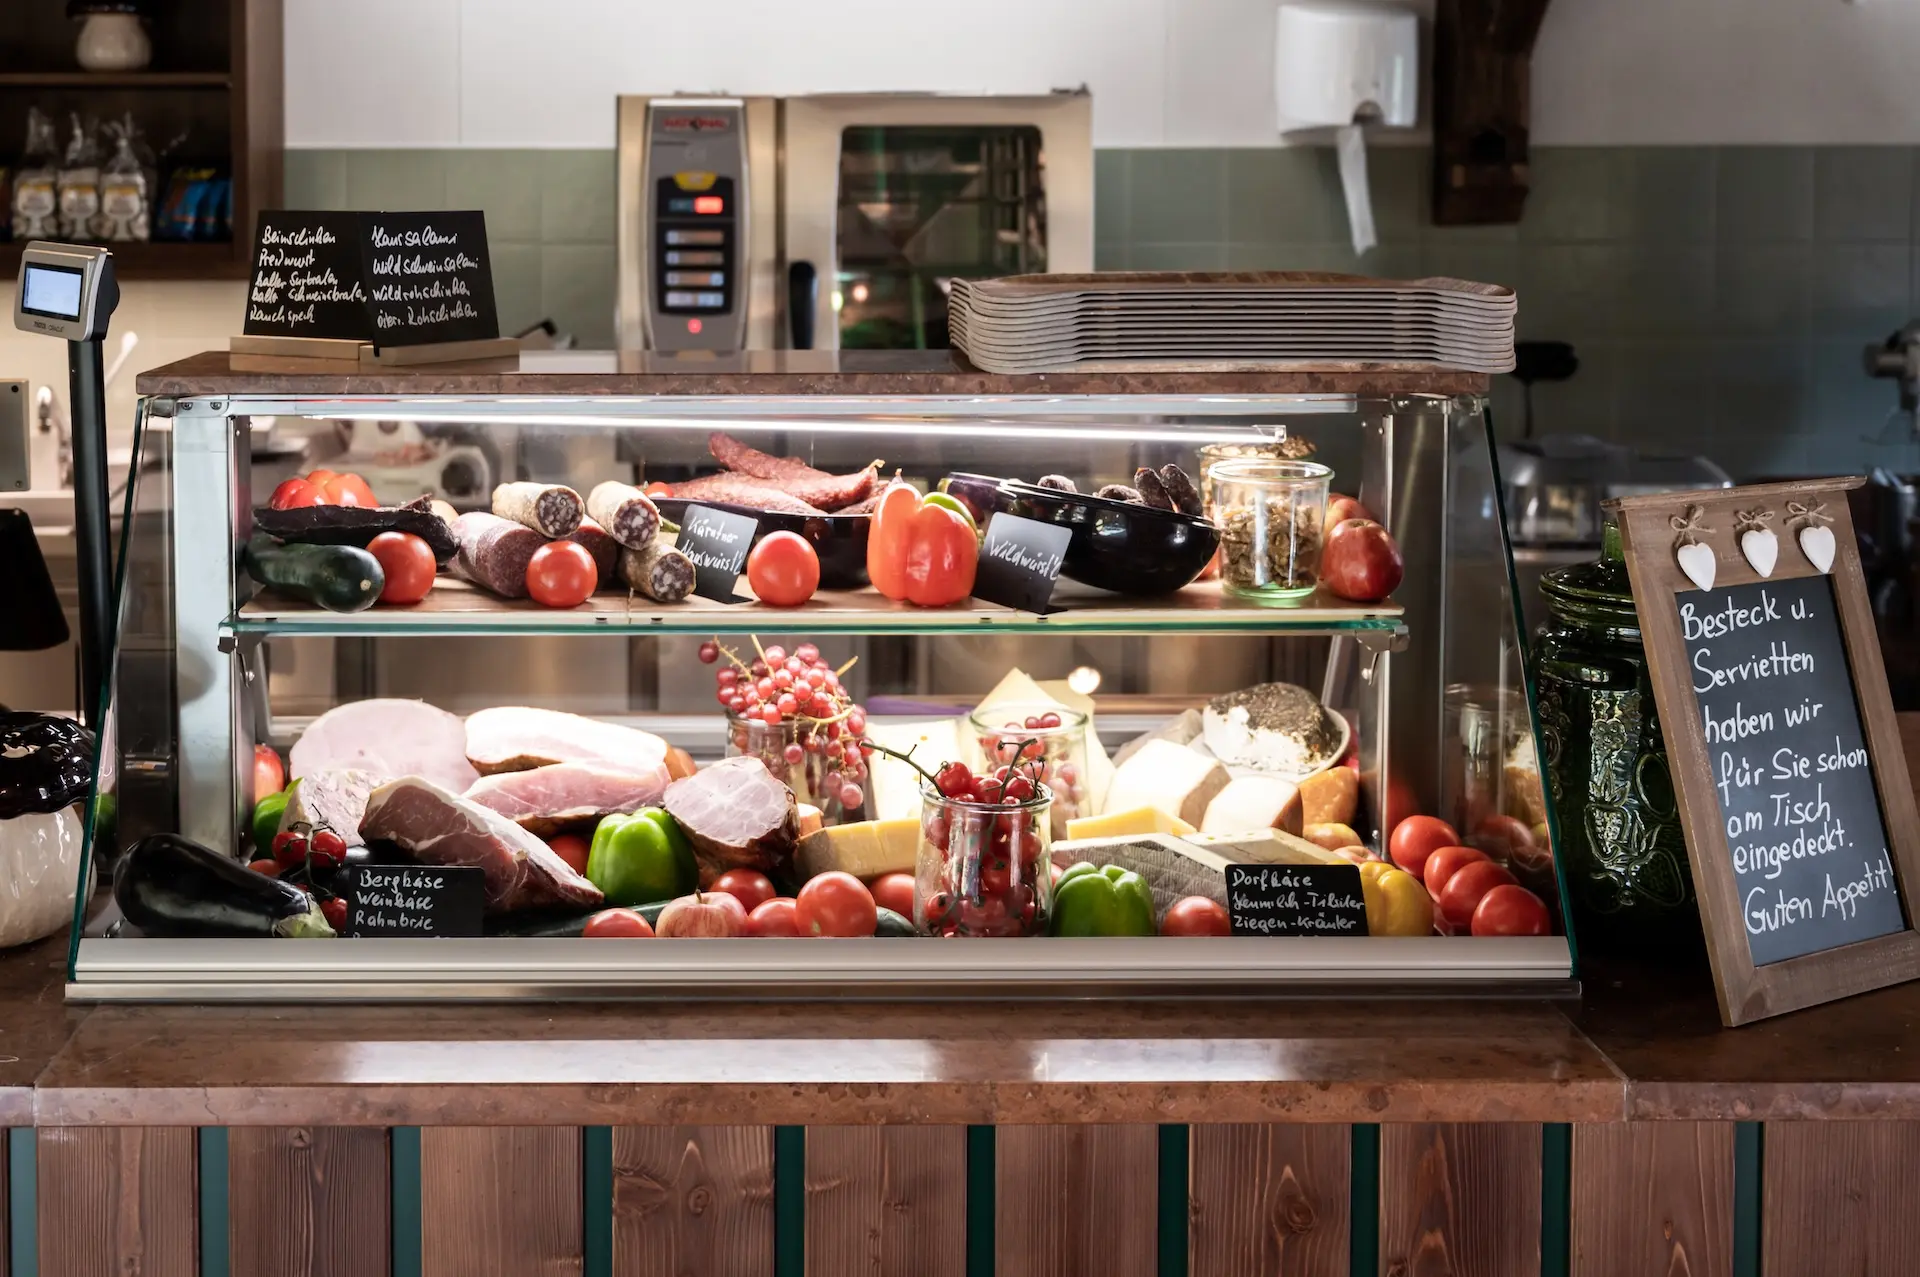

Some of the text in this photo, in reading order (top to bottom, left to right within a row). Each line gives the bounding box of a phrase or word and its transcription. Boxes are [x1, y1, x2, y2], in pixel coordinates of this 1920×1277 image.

[1680, 589, 1815, 640] Besteck u.
[1693, 640, 1814, 693] Servietten
[1704, 698, 1823, 744] haben wir
[1717, 735, 1868, 807] für Sie schon
[1726, 782, 1831, 839] am Tisch
[1733, 818, 1854, 880] eingedeckt.
[1744, 848, 1898, 935] Guten Appetit!
[355, 909, 434, 931] Rahmbrie
